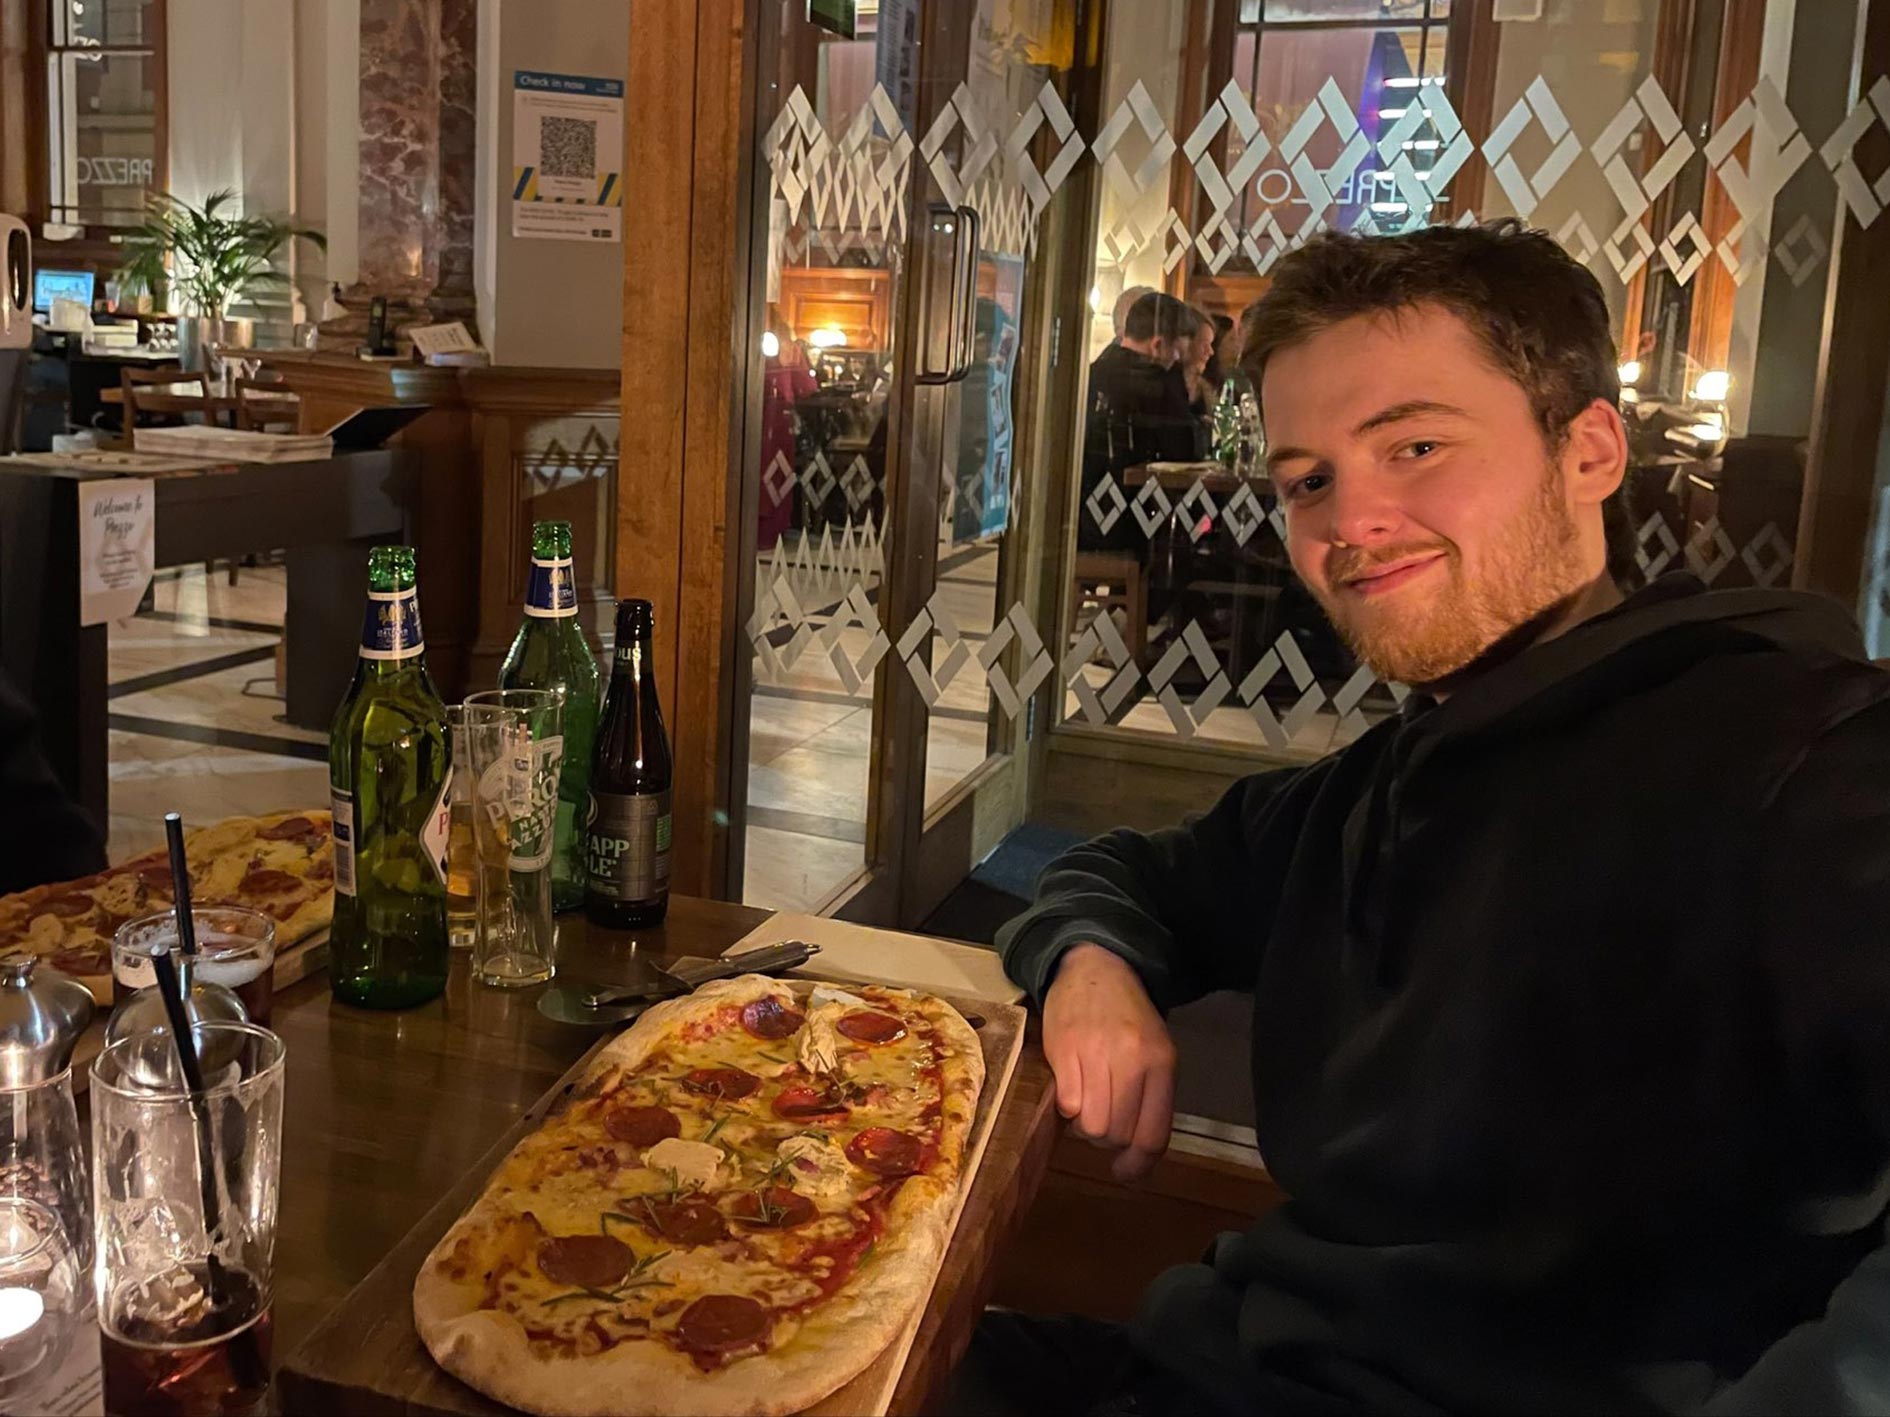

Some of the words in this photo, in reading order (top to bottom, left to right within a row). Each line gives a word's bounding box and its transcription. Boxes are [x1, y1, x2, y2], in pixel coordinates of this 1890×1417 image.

[520, 75, 549, 87] Check
[551, 80, 562, 88] in
[564, 81, 586, 90] now
